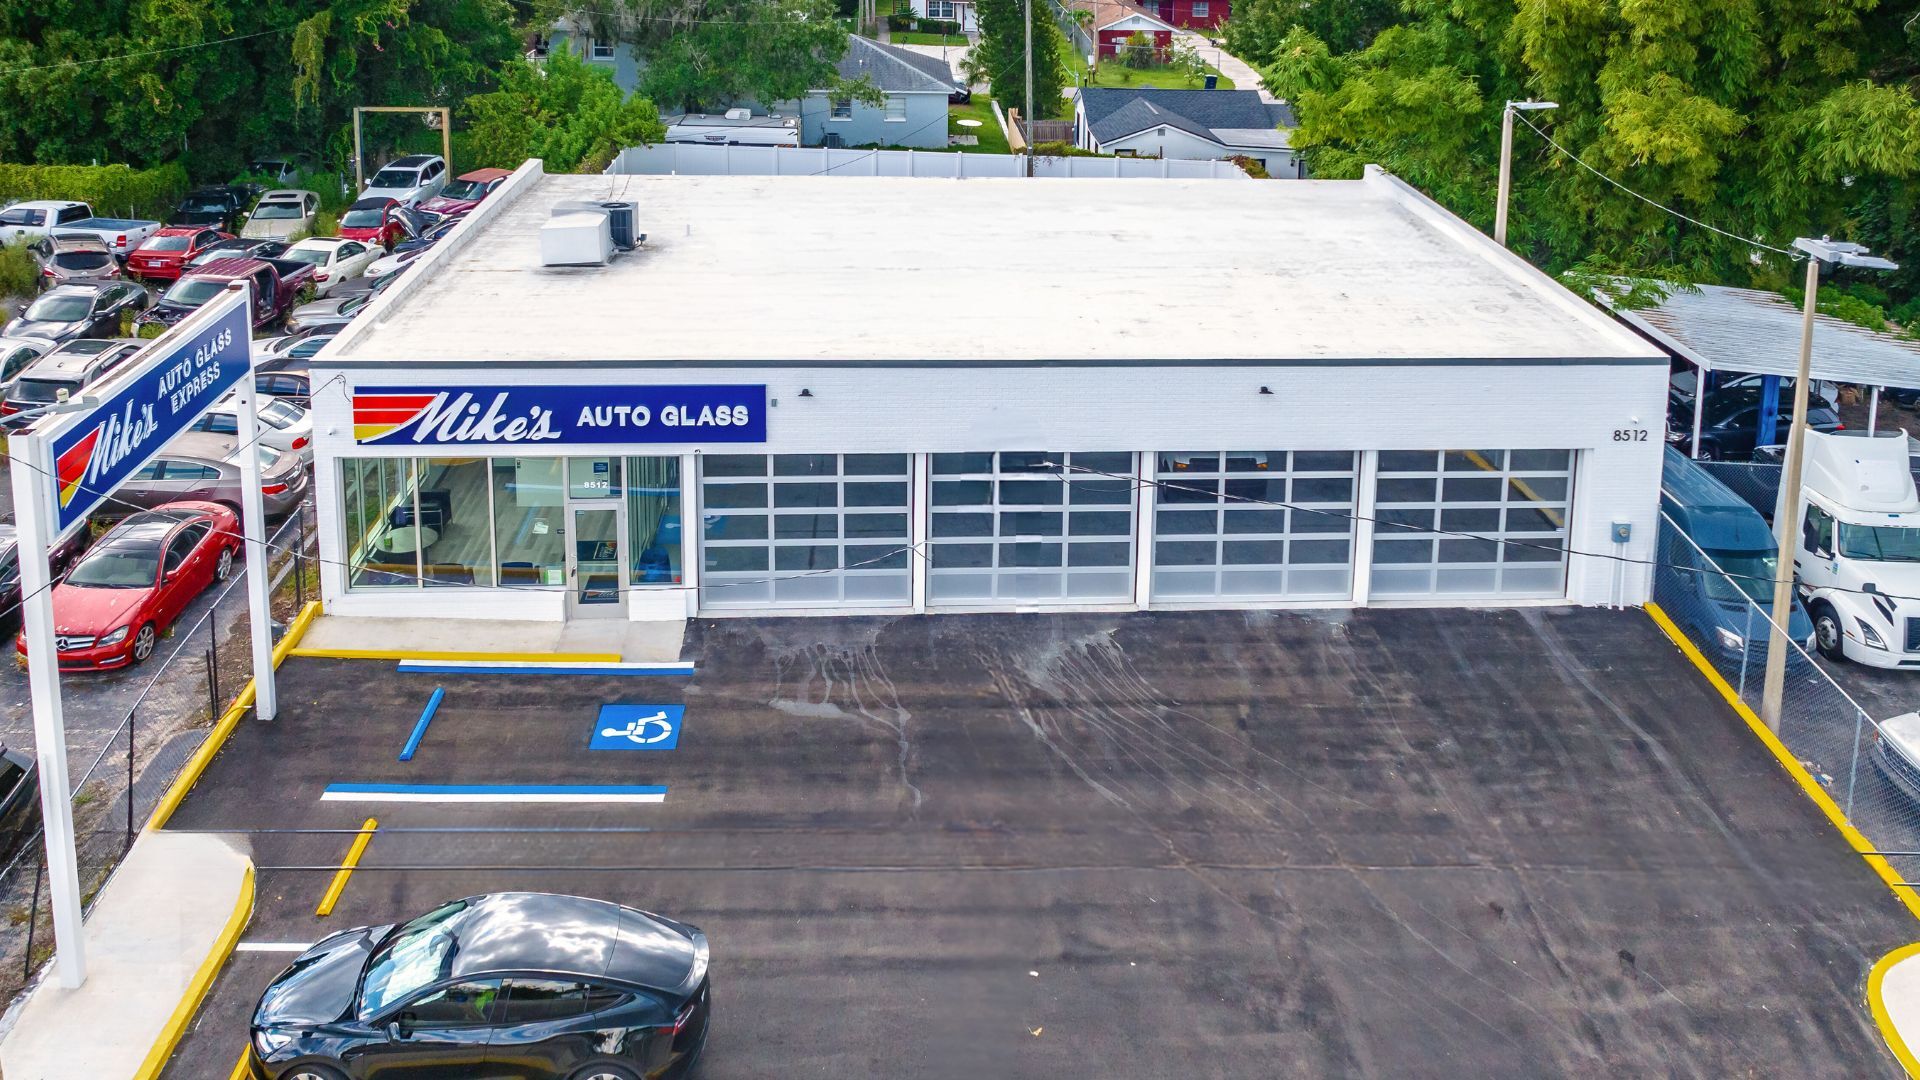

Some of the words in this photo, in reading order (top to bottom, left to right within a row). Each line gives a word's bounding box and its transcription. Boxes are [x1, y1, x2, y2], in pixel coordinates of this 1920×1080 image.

[157, 357, 192, 400] AUTO
[195, 327, 232, 369] GLASS
[170, 361, 221, 416] EXPRESS
[89, 398, 158, 485] Mike's
[411, 391, 562, 443] Mike's
[576, 405, 651, 427] AUTO
[660, 405, 749, 427] GLASS
[1613, 429, 1648, 442] 8512
[583, 481, 608, 489] 8512
